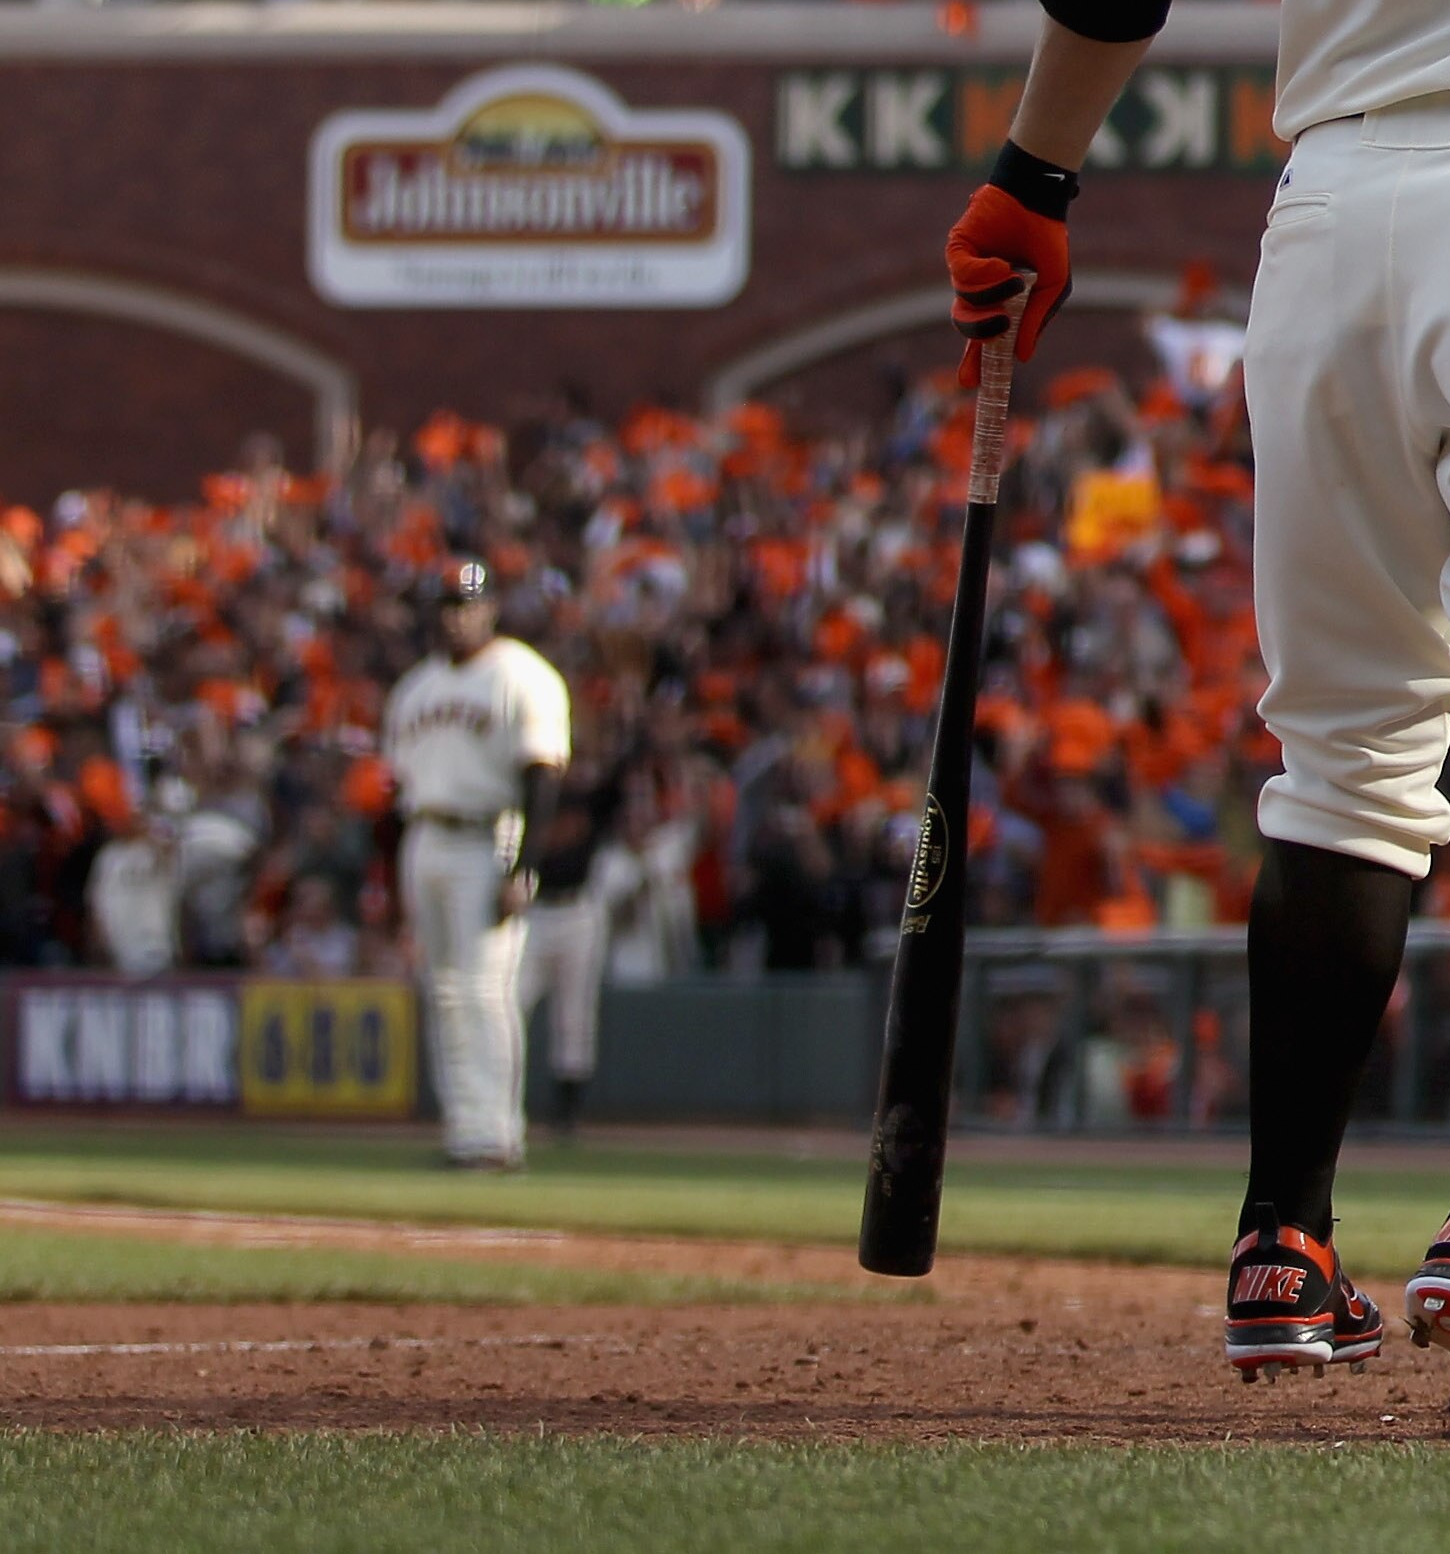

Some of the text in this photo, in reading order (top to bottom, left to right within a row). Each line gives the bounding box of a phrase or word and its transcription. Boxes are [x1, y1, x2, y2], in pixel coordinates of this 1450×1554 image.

[352, 151, 706, 233] Johnsonville
[912, 805, 939, 901] Louisville
[18, 987, 236, 1102] KNBR
[1232, 1264, 1308, 1304] NIKE
